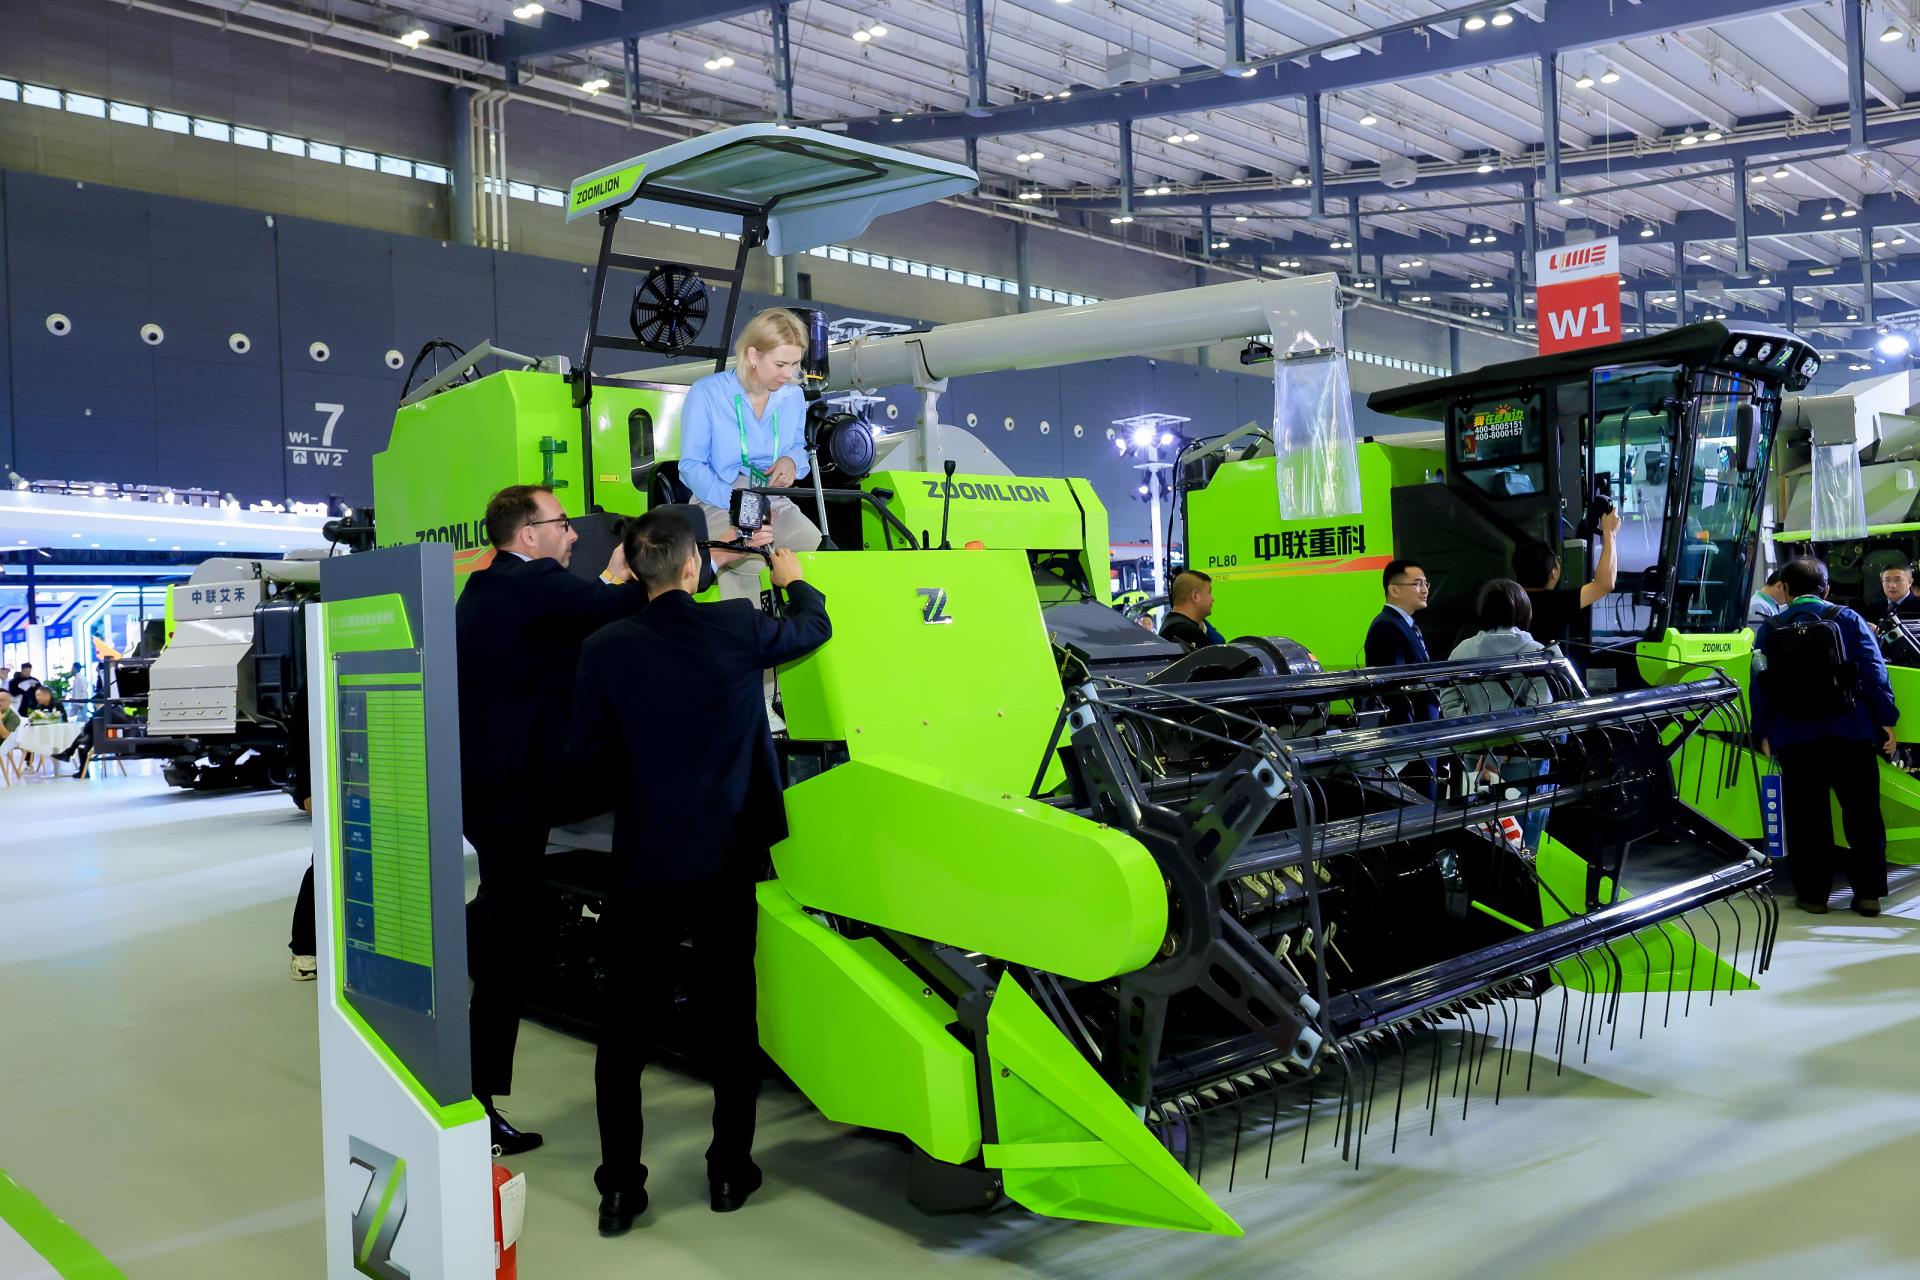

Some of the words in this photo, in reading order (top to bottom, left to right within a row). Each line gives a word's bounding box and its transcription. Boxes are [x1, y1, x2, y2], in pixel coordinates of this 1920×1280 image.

[576, 176, 620, 205] ZOOMLION
[1548, 303, 1610, 340] W1
[1475, 420, 1522, 433] 400-8005151
[1475, 428, 1523, 441] 400-8000157
[922, 480, 1050, 502] ZOOMLION
[1254, 524, 1366, 561] 中联重科
[1209, 554, 1237, 568] PL80
[192, 587, 245, 605] 中联艾禾
[1702, 643, 1731, 652] ZOOMLION
